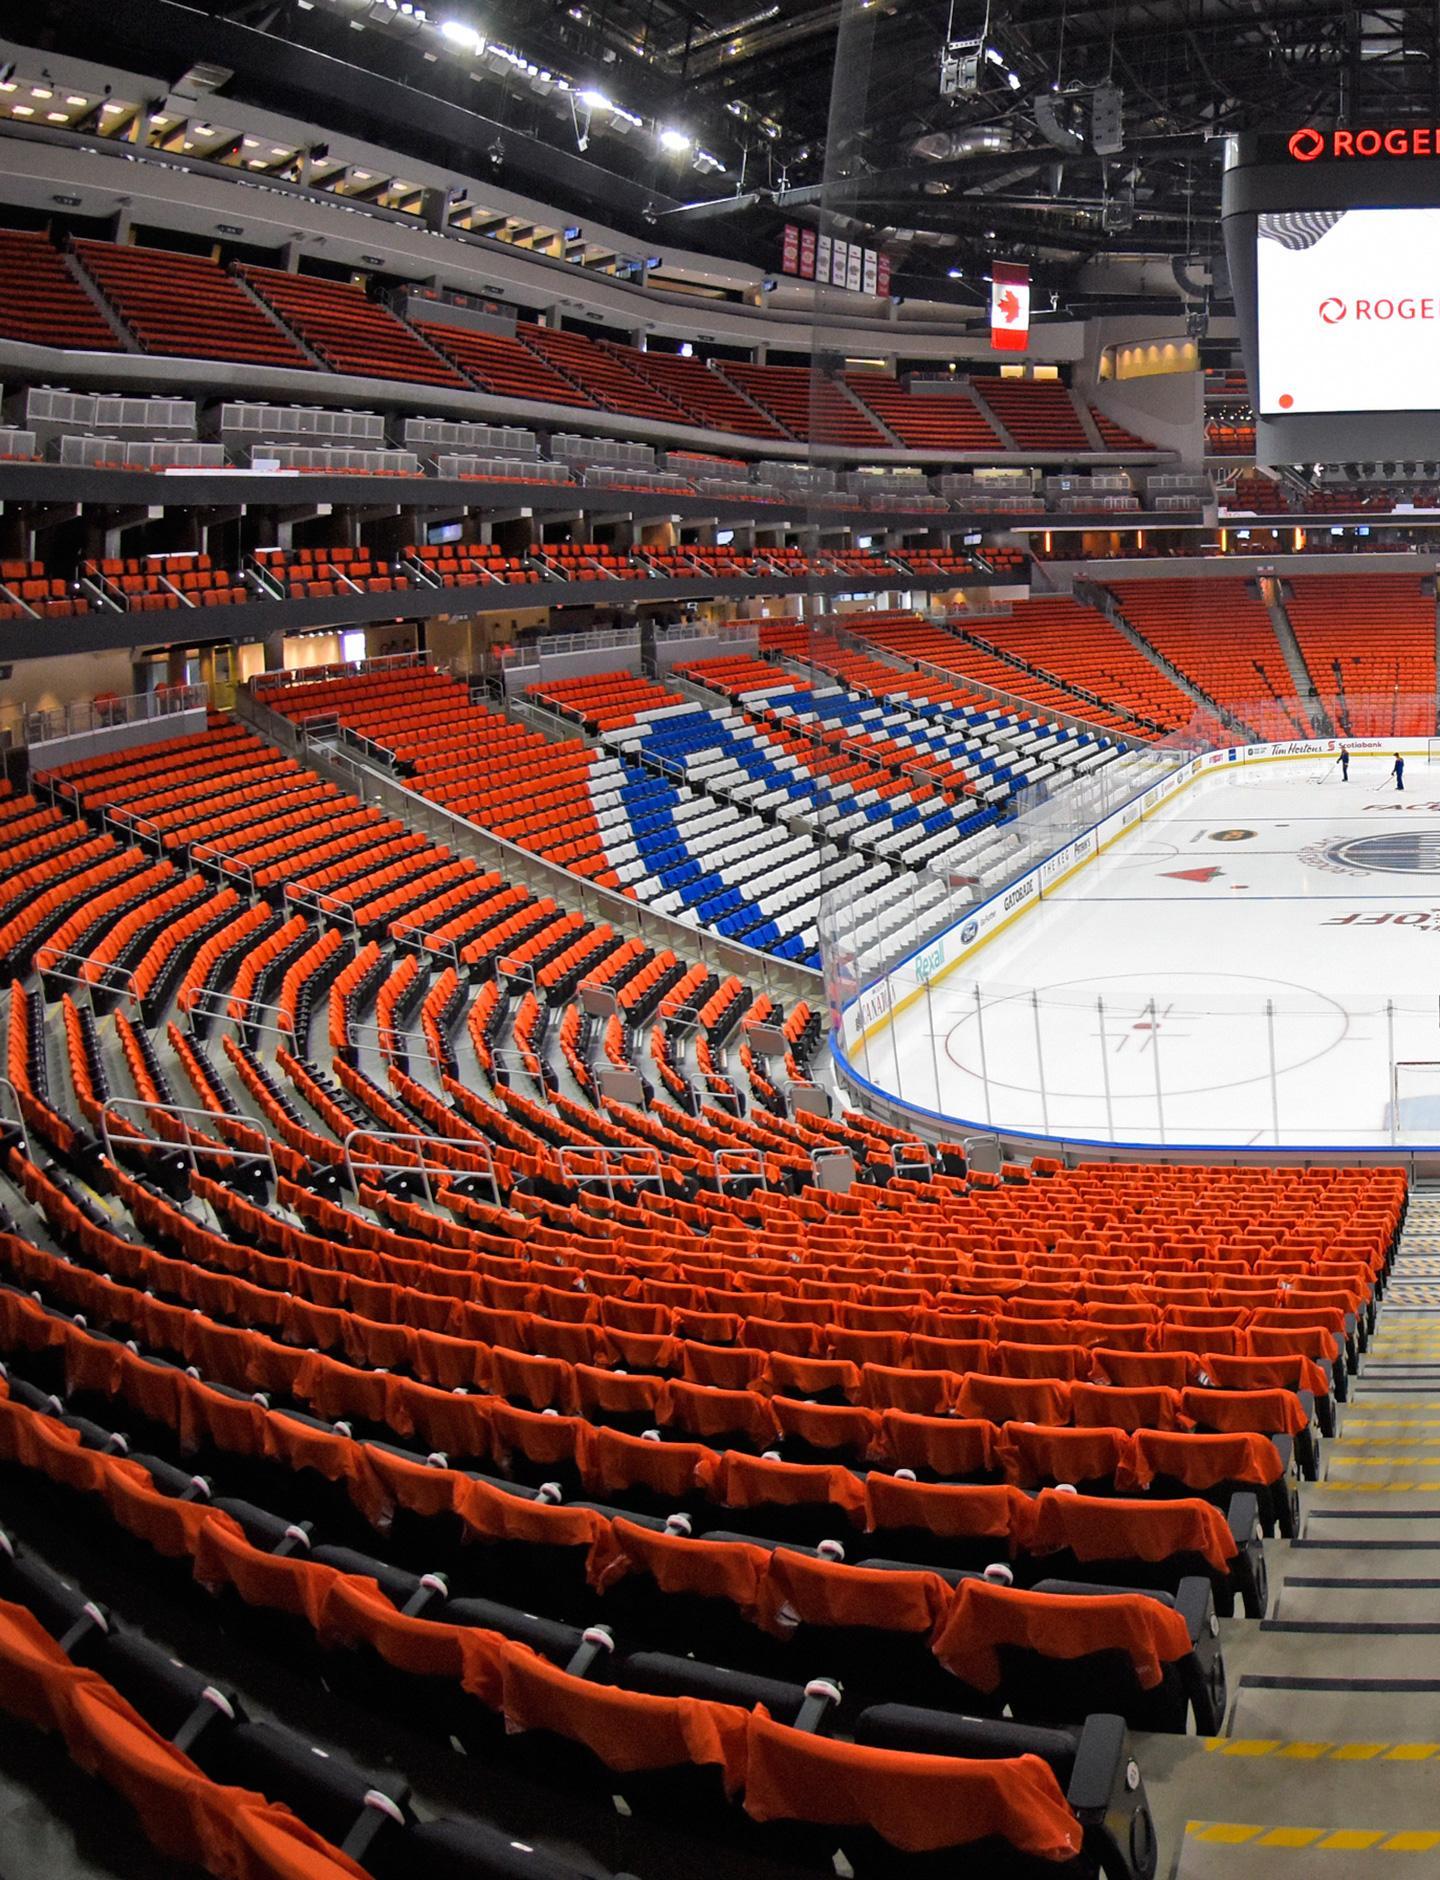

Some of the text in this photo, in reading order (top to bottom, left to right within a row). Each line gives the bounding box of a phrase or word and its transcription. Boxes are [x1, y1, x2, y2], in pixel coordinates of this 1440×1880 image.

[1271, 743, 1287, 756] Tim
[1287, 742, 1323, 755] Hortons
[1338, 740, 1382, 749] Scotiabank
[1003, 879, 1034, 911] GATORADE
[914, 940, 945, 982] Rexall
